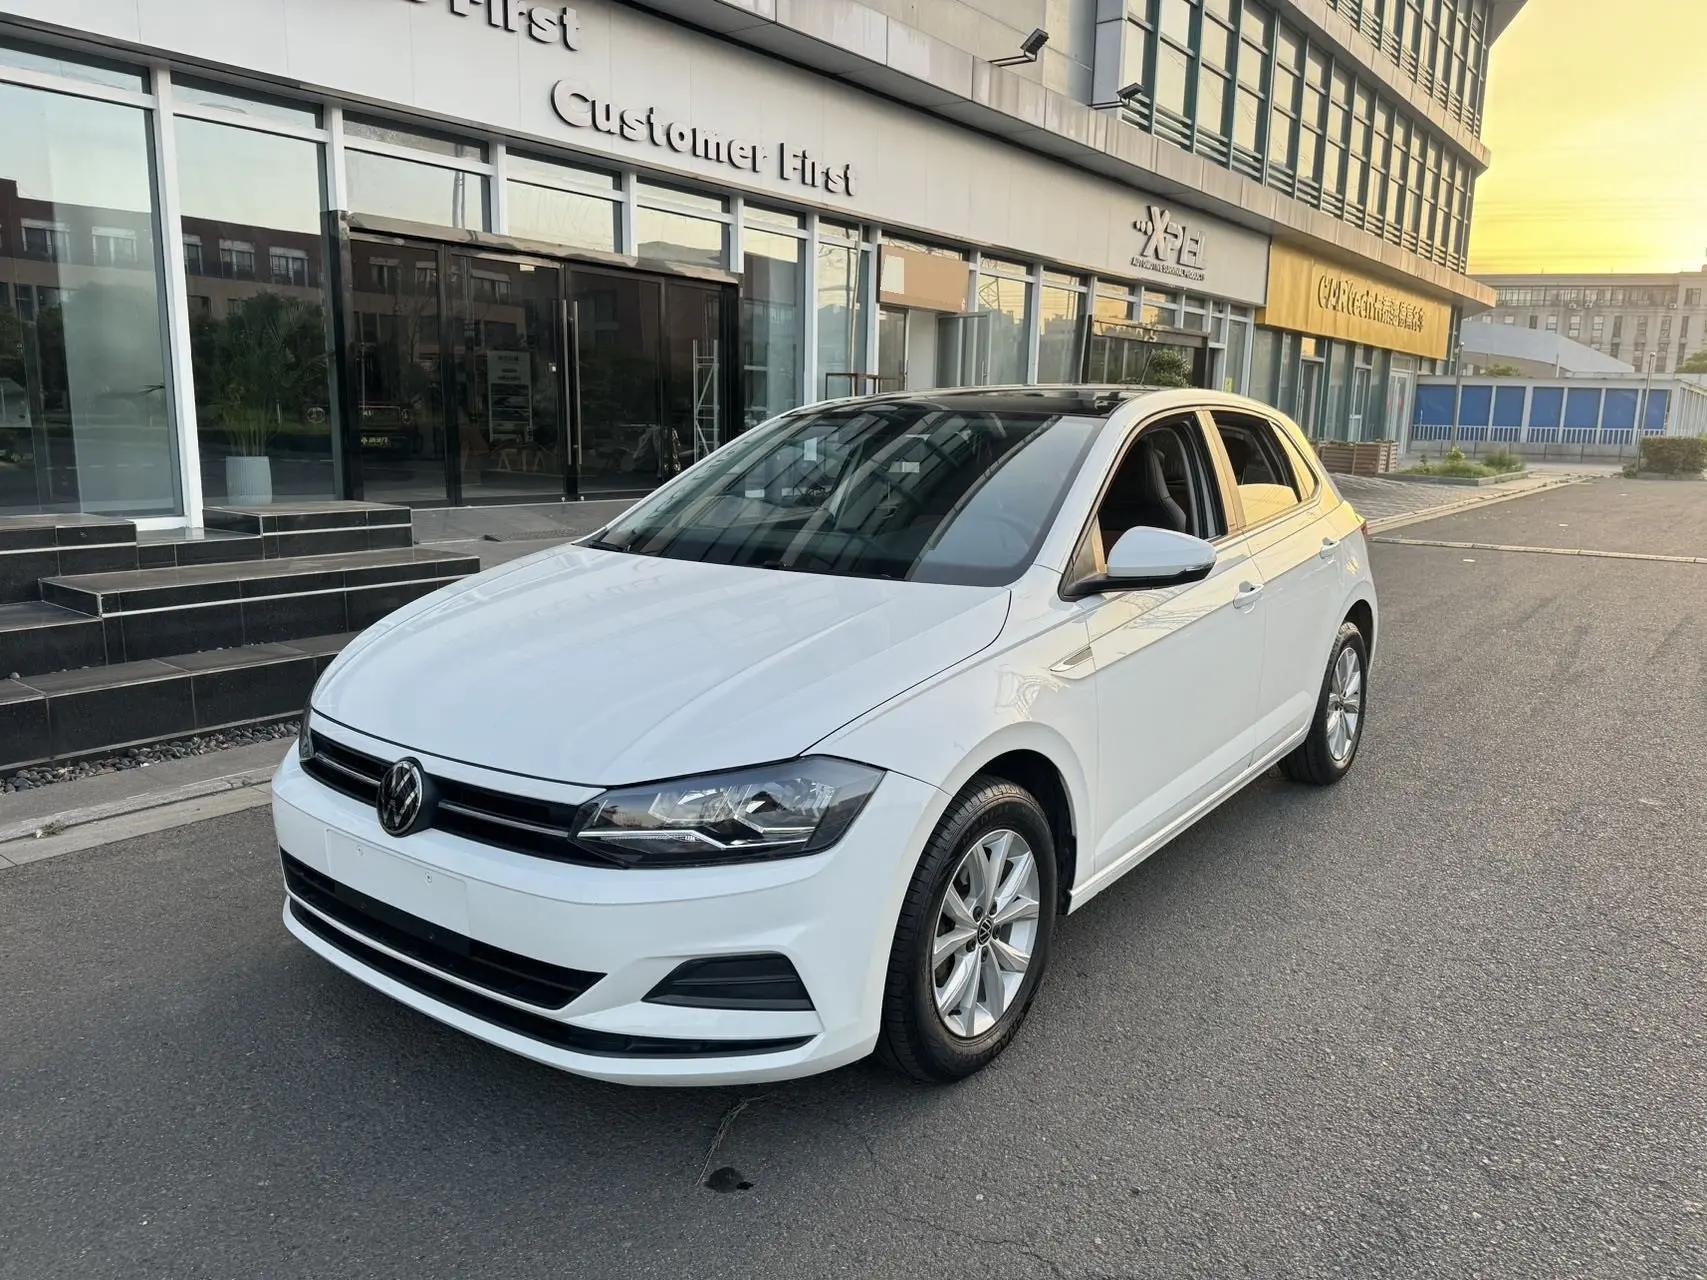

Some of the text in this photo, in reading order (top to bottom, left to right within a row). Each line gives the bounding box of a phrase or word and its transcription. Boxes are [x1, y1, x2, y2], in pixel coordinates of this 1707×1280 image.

[551, 79, 857, 196] Customer First
[1140, 205, 1206, 270] XPEL
